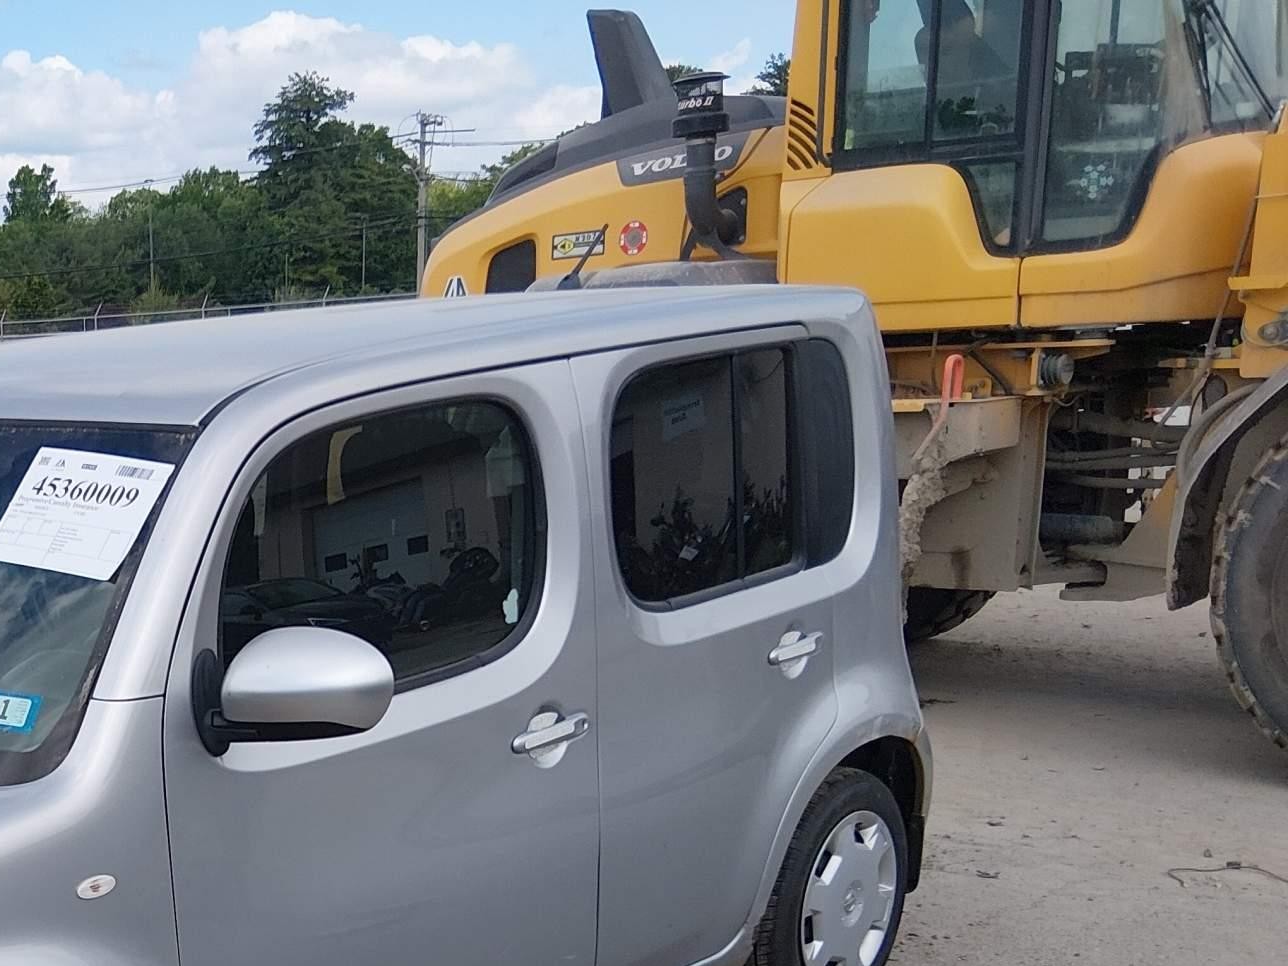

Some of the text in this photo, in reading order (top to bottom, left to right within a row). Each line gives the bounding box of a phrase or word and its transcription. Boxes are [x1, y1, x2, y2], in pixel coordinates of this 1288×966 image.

[677, 97, 702, 111] turbo
[632, 145, 733, 176] VOLO
[32, 475, 140, 508] 45360009
